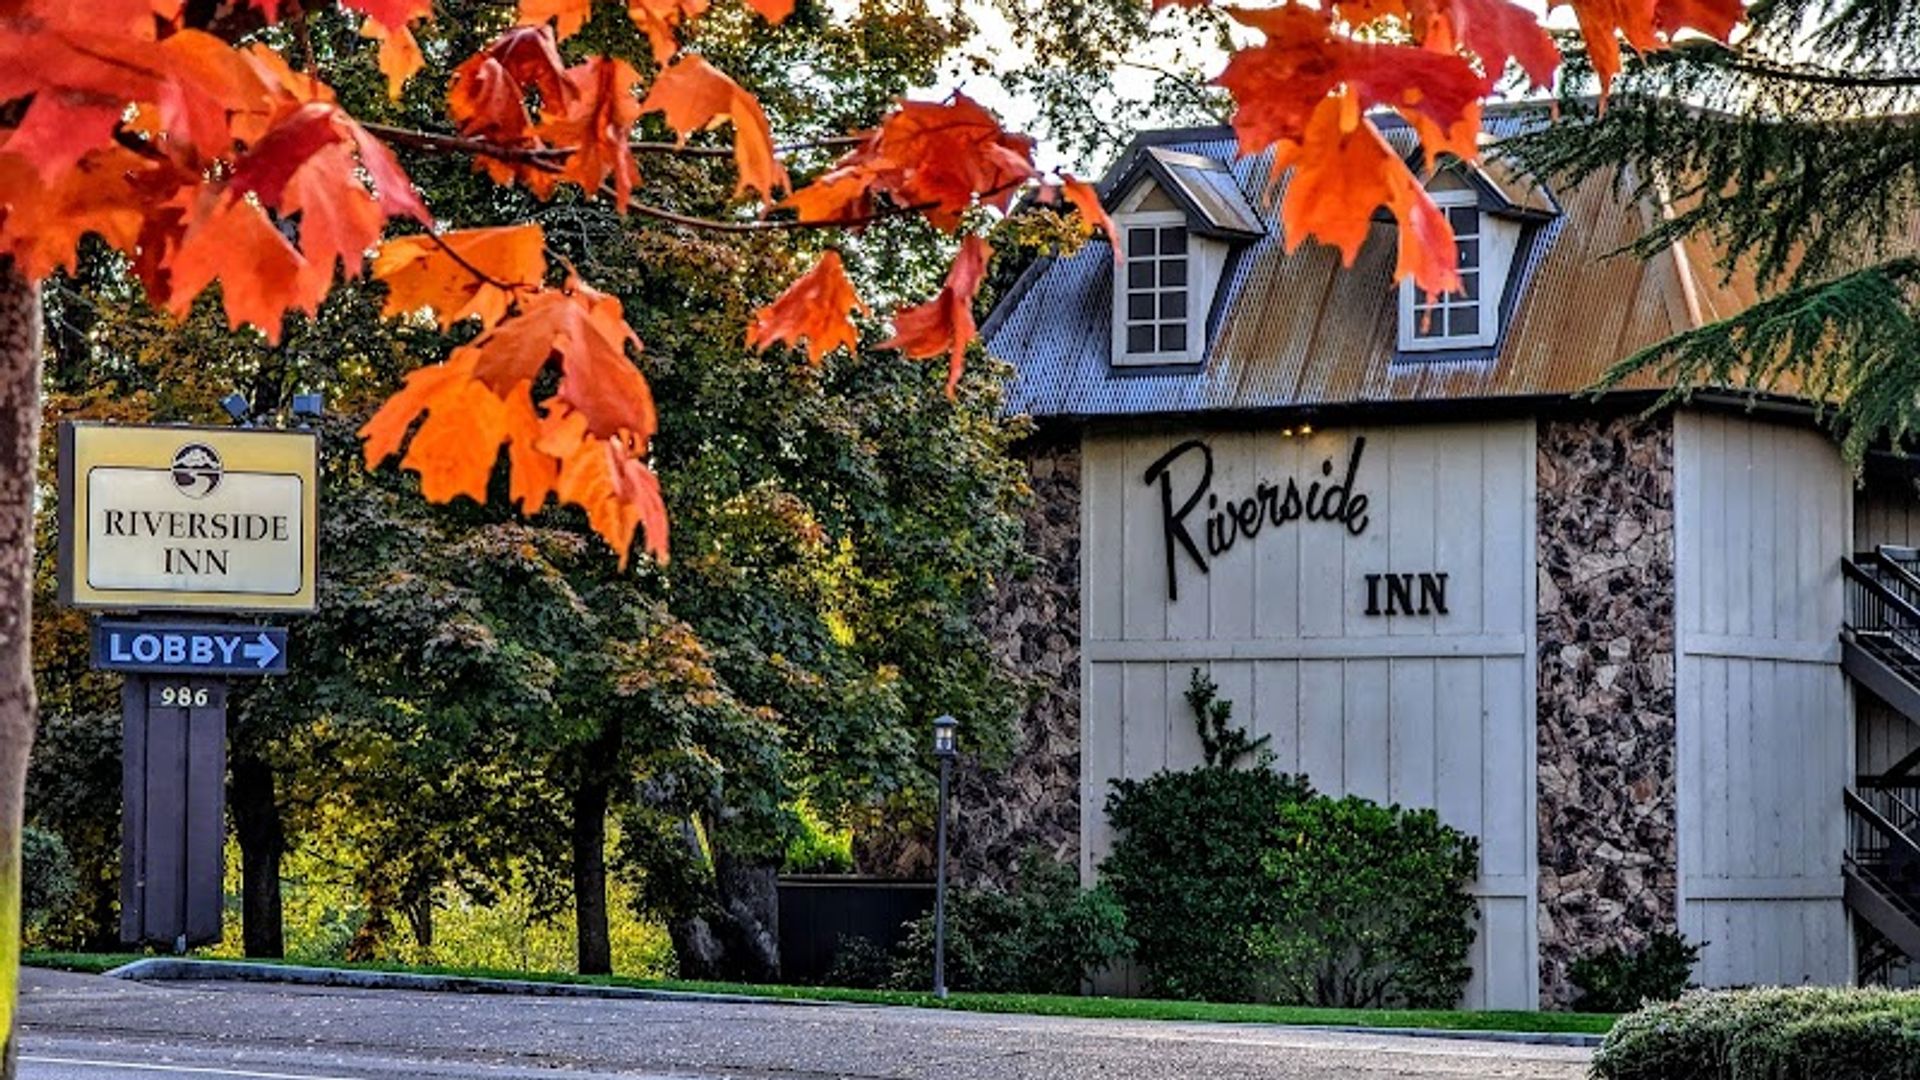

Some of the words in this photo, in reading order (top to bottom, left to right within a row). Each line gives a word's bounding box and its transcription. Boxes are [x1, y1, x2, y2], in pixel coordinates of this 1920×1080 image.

[103, 509, 289, 541] RIVERSIDE
[1144, 436, 1369, 601] Riverside
[163, 548, 230, 575] INN
[1363, 573, 1449, 616] INN
[110, 633, 241, 664] LOBBY
[161, 687, 208, 707] 986
